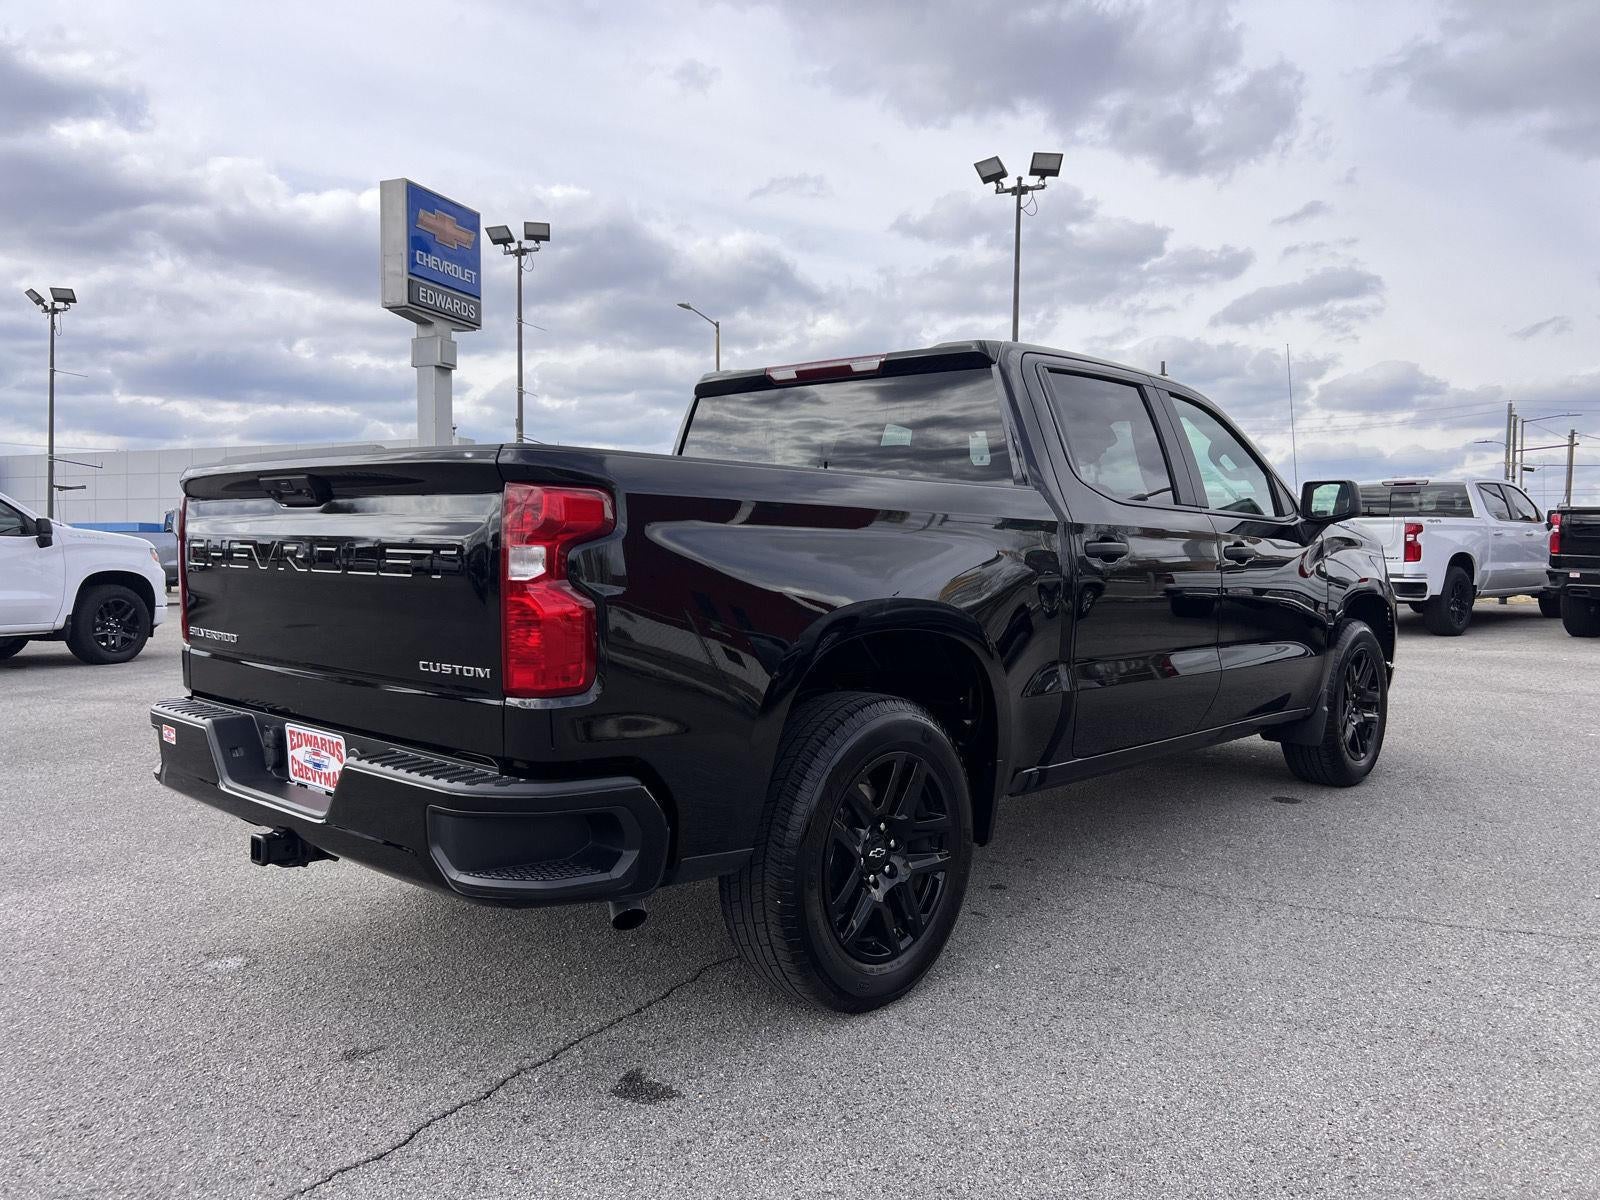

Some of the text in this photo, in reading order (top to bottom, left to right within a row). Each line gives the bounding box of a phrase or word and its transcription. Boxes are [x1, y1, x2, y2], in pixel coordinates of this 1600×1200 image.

[416, 251, 477, 284] CHEVROLET
[419, 287, 476, 319] EDWARDS
[189, 540, 458, 578] CHEVROLET
[189, 626, 239, 643] SILVERADO
[419, 660, 491, 679] CUSTOM
[288, 729, 344, 765] EDWARDS
[291, 754, 340, 788] CHEVYMA
